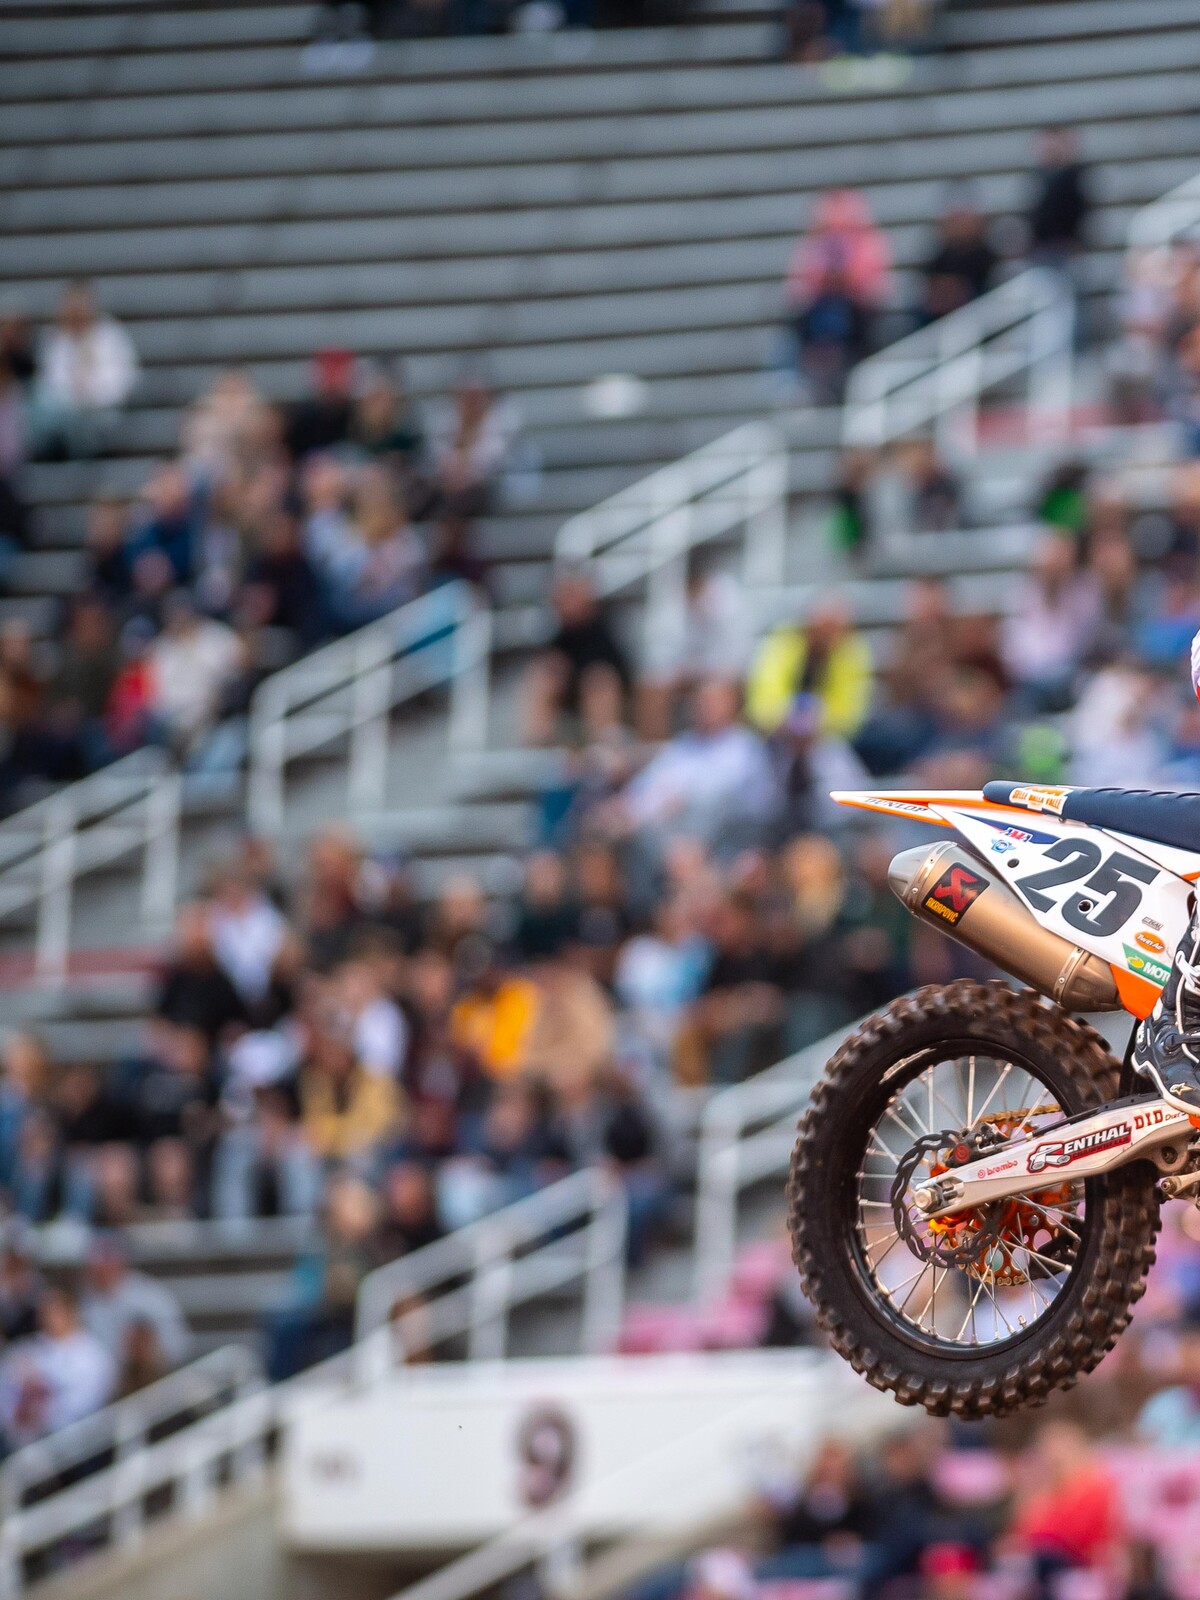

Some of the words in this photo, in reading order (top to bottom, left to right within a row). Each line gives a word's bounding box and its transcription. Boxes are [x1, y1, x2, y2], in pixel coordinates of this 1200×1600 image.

[864, 798, 929, 813] DUNLOP
[1014, 837, 1160, 938] 25
[1143, 961, 1171, 982] MOT
[987, 1160, 1018, 1176] brembo
